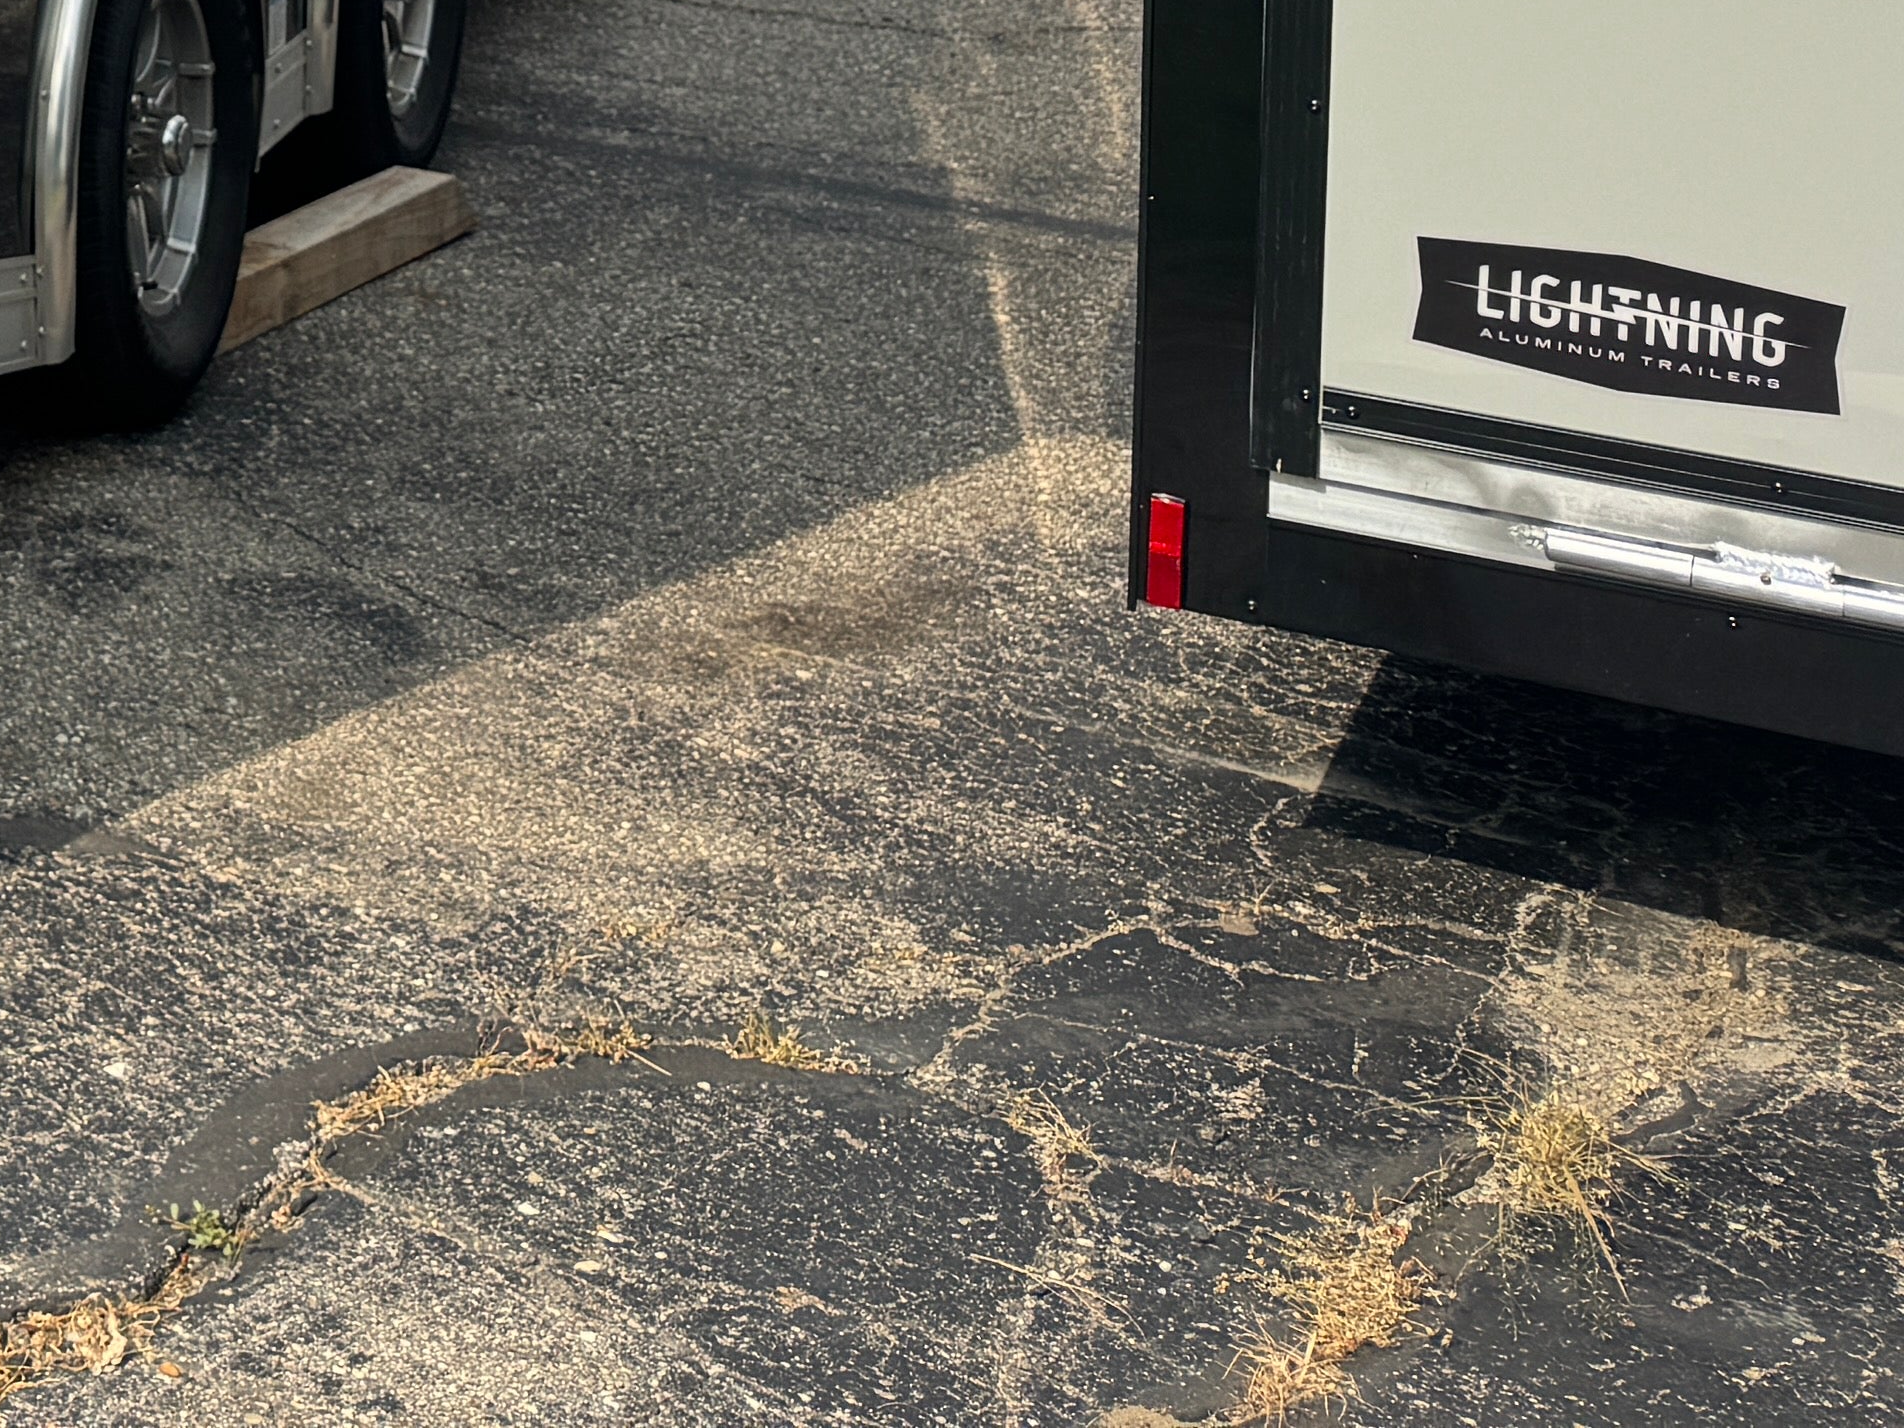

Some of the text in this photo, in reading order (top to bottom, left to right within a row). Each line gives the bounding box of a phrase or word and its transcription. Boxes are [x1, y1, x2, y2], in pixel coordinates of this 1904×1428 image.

[1477, 264, 1786, 367] LIGHTNING
[1480, 327, 1780, 389] ALUMINUM TRAILERS
